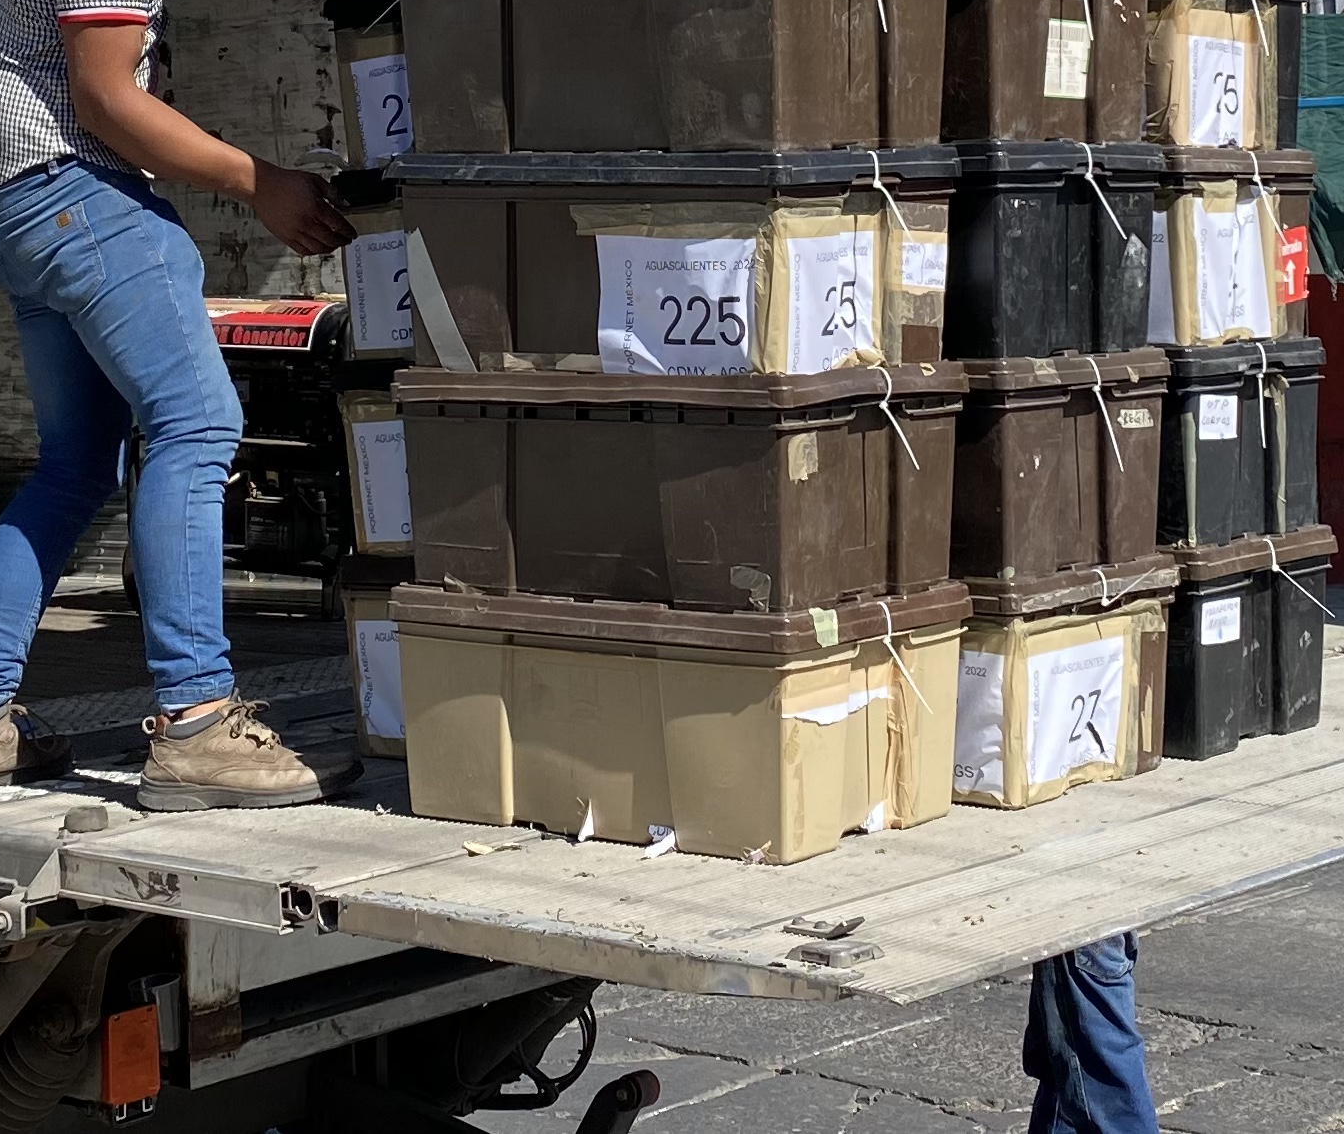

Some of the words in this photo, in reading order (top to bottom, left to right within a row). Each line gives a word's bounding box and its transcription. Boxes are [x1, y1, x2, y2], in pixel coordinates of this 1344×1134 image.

[382, 94, 408, 137] 2
[645, 260, 727, 271] AGUASCALIENTES
[732, 258, 756, 271] 2022
[232, 325, 306, 347] Generator
[357, 286, 367, 341] PODERNET
[660, 295, 746, 346] 225
[623, 309, 636, 374] PODERNET
[365, 478, 377, 534] PODERNET
[965, 665, 987, 678] 2022
